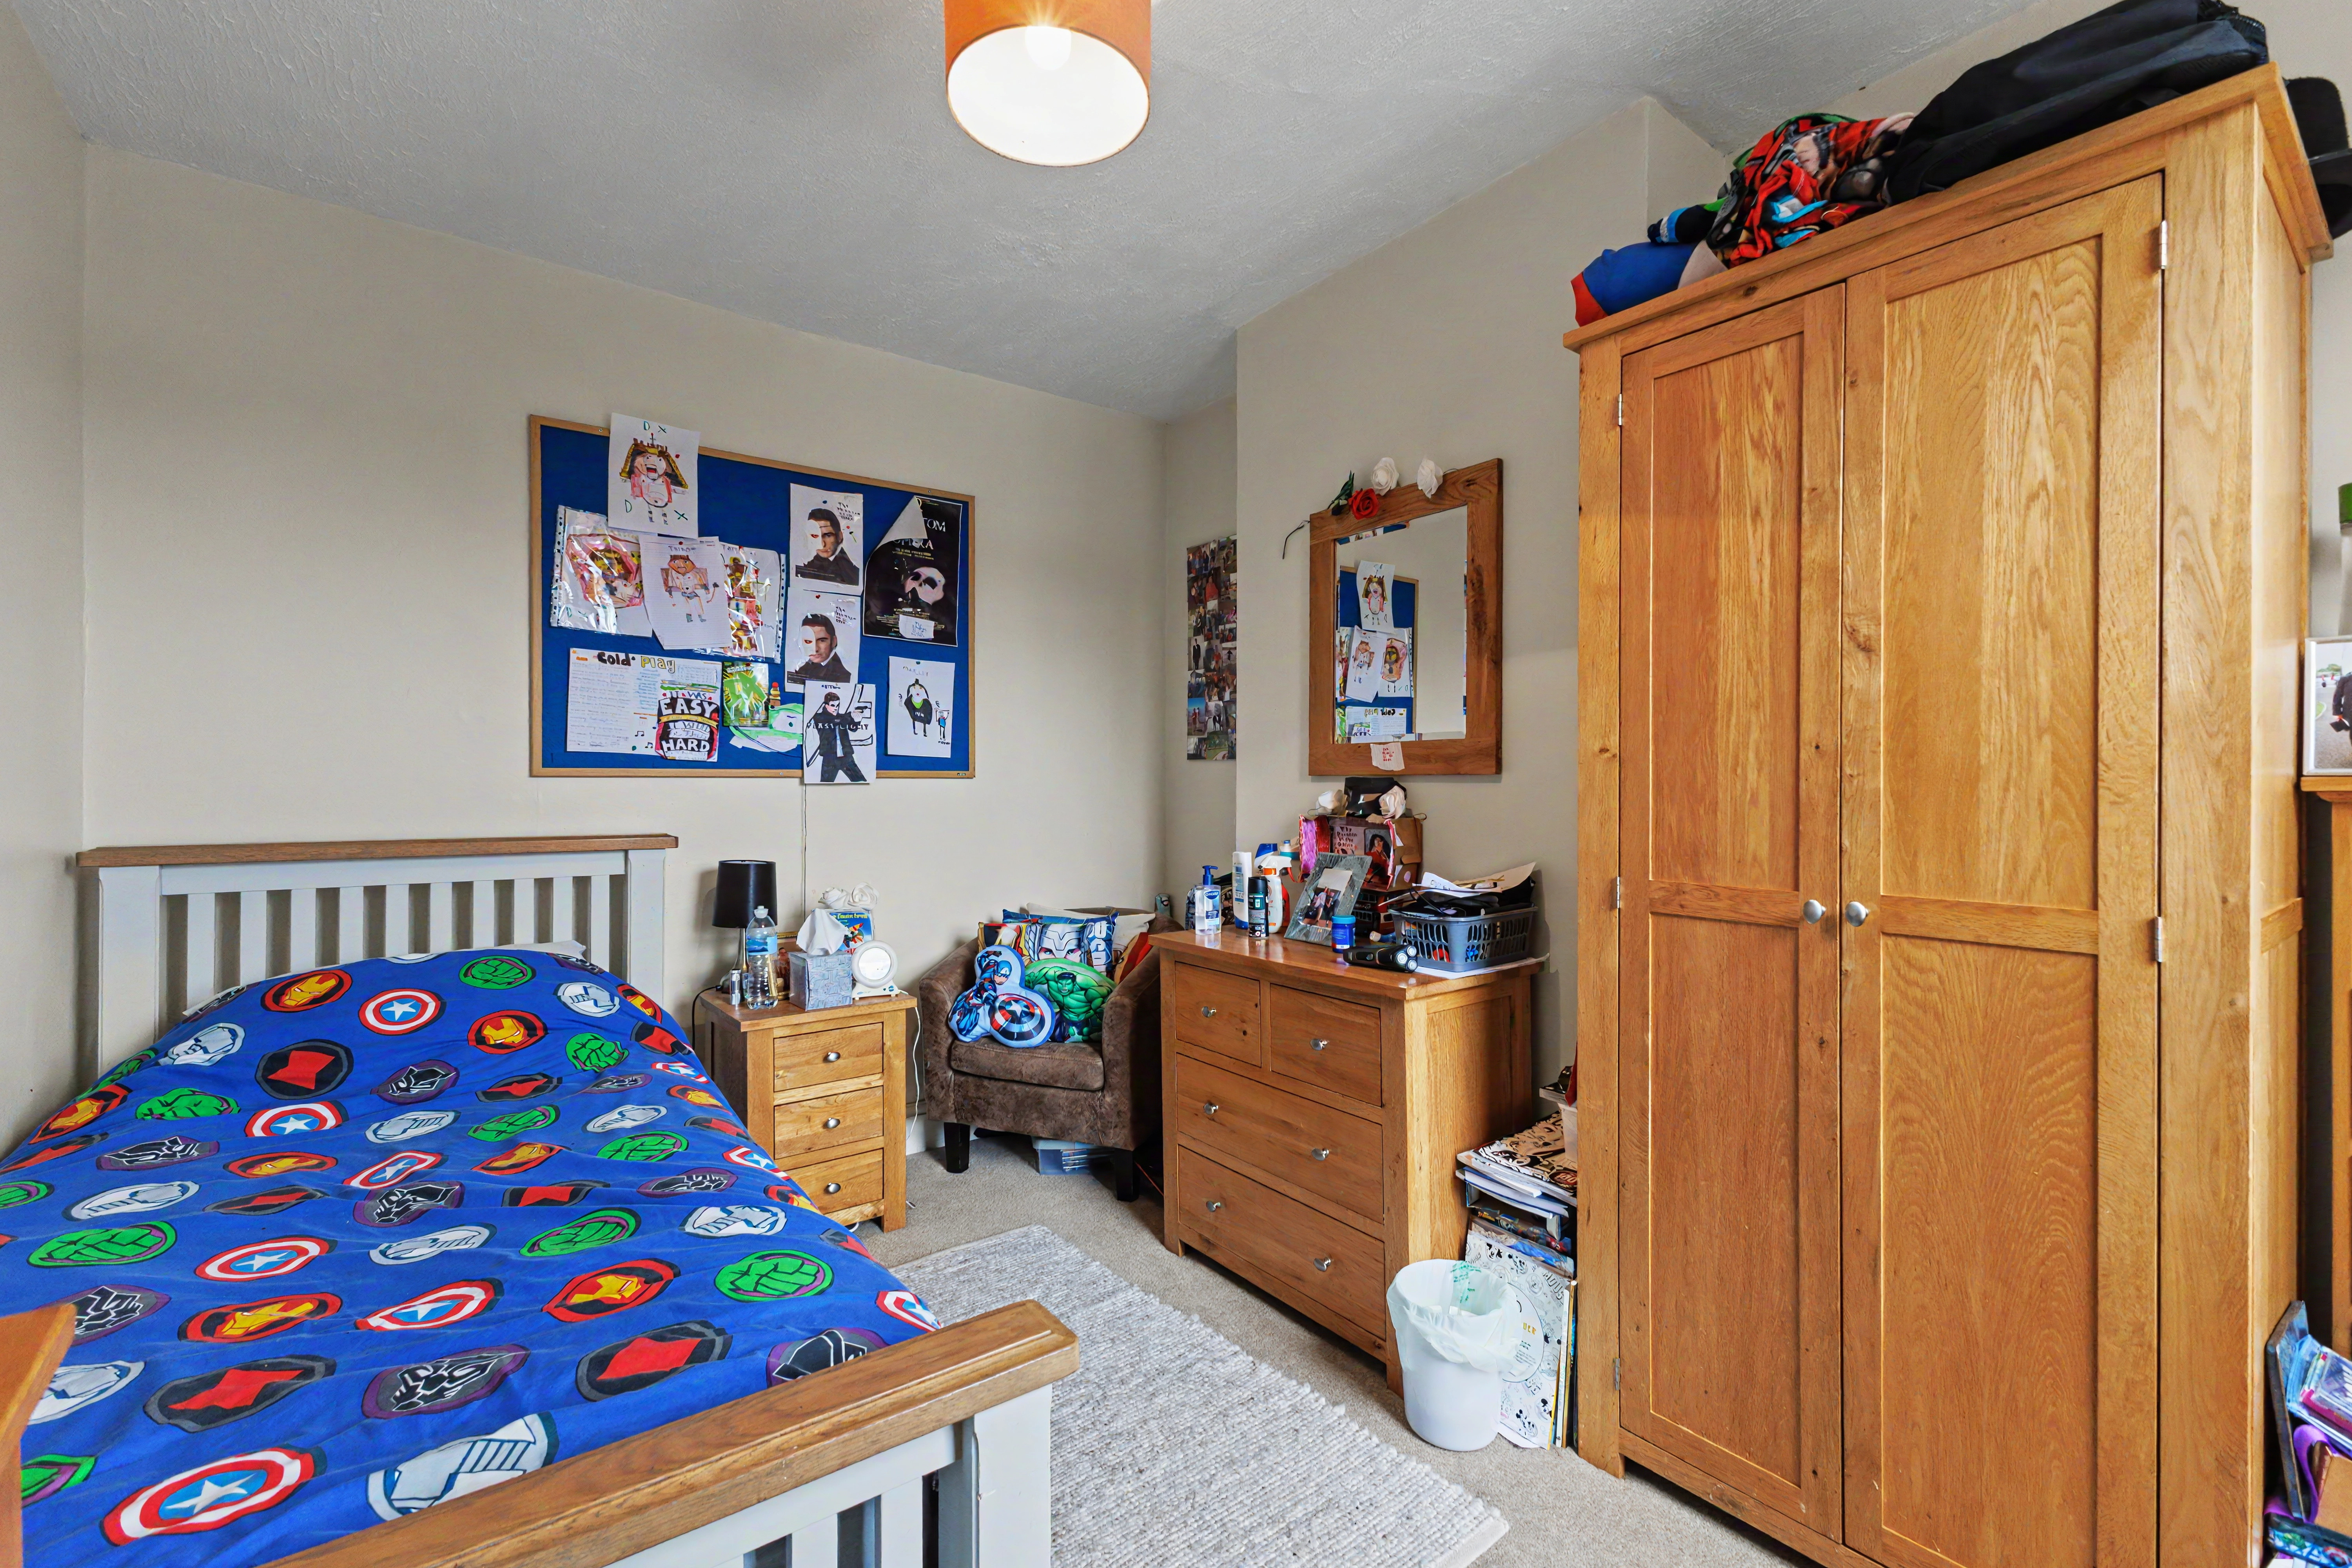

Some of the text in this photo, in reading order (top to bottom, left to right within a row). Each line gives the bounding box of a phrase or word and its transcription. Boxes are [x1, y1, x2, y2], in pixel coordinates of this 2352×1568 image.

[597, 651, 676, 674] Cold Play
[687, 691, 707, 700] WAS
[660, 698, 717, 718] EASY
[661, 739, 710, 752] HARD
